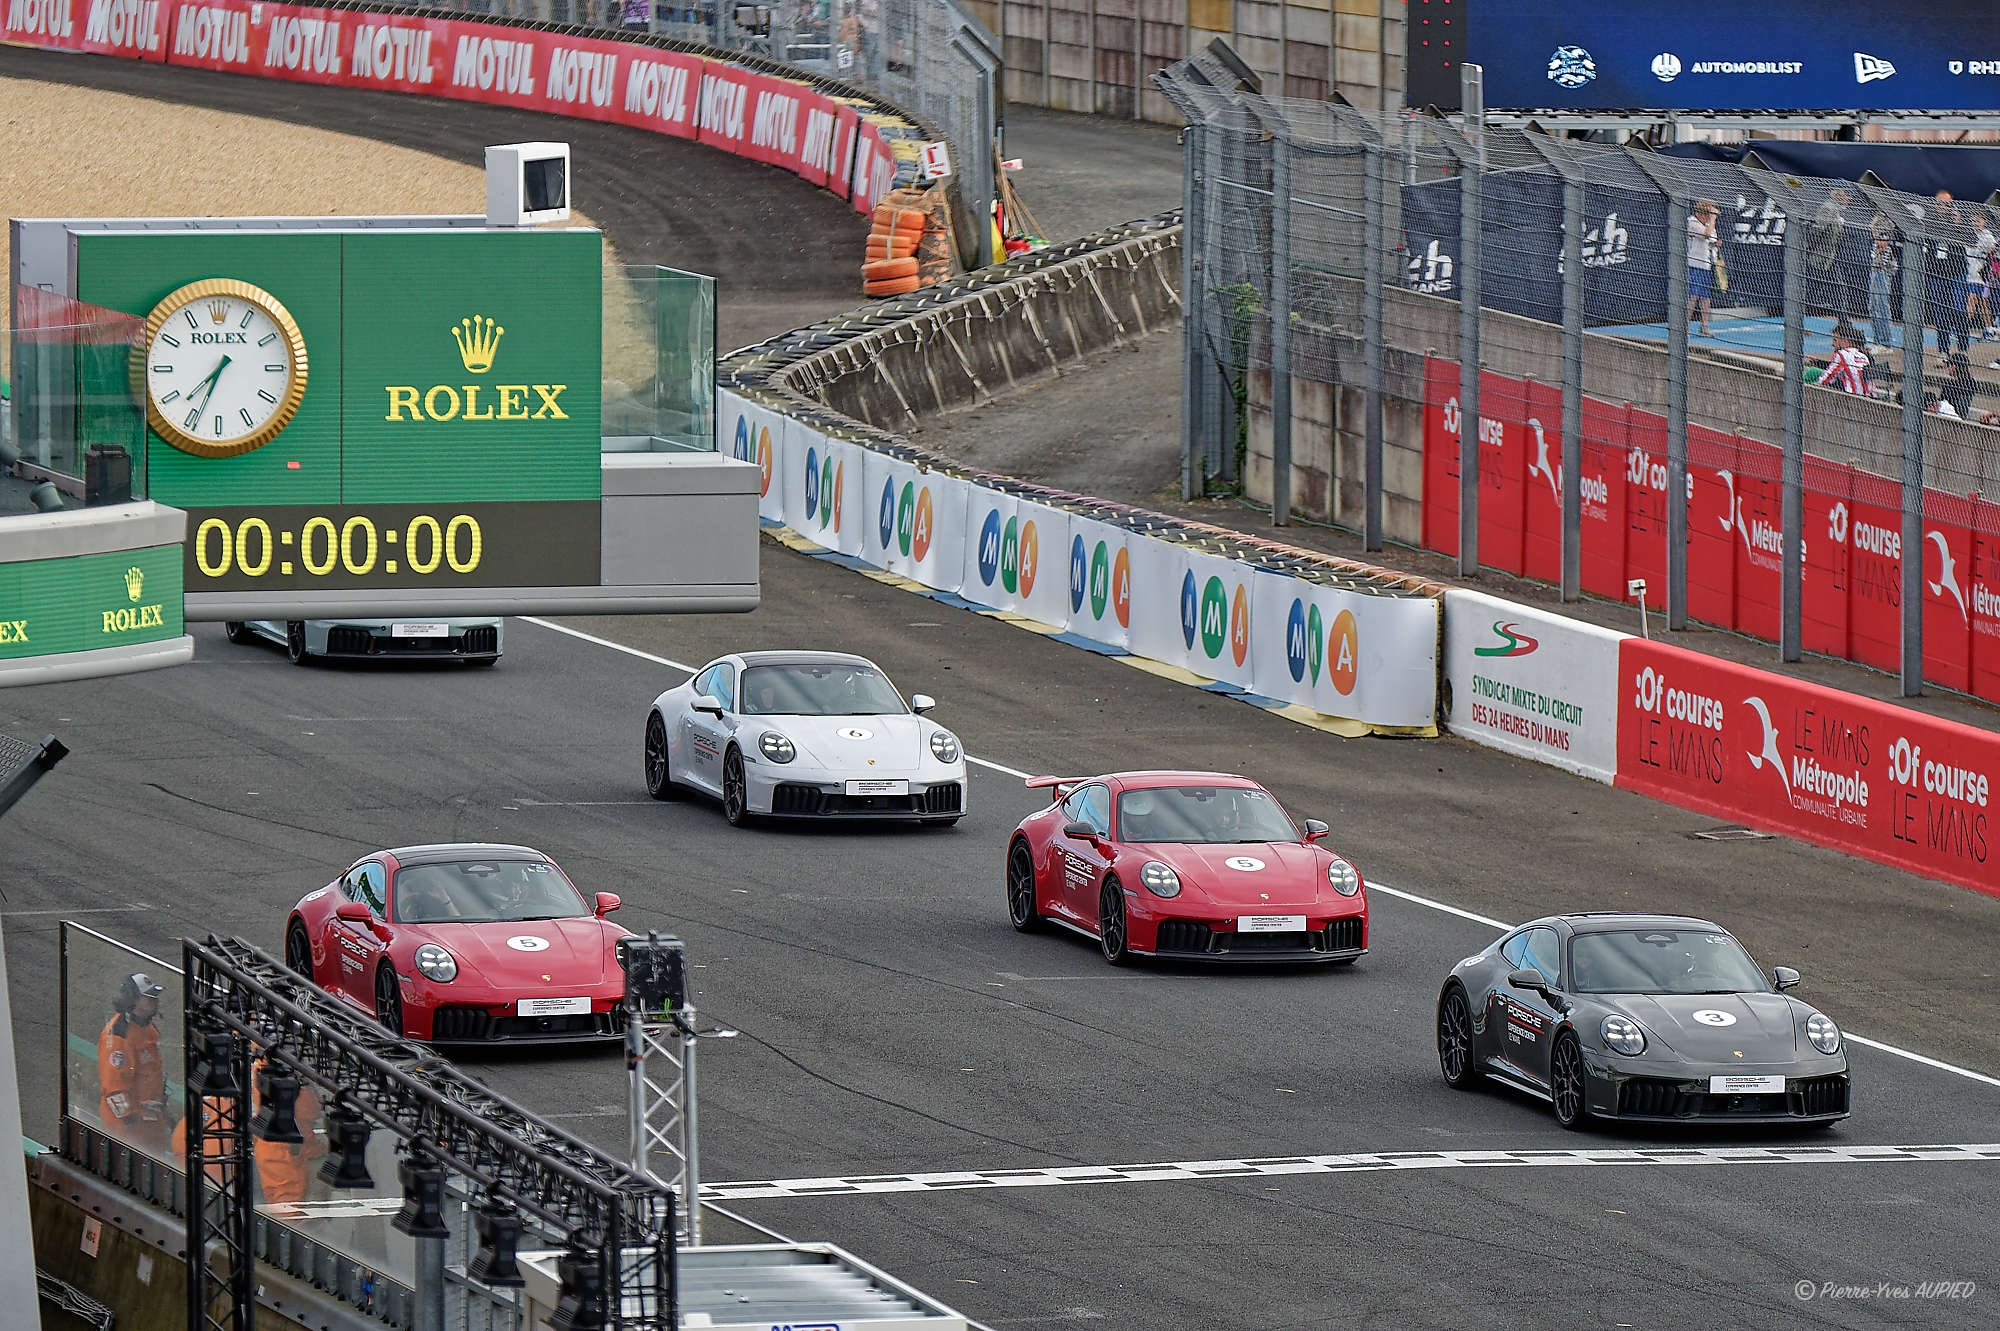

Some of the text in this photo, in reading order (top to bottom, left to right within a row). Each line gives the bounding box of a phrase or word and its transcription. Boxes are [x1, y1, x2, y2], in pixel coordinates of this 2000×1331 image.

[85, 0, 159, 50] MOTUL
[174, 4, 250, 64] MOTUL
[264, 15, 342, 74] MOTUL
[351, 24, 434, 83] MOTUL
[453, 35, 535, 96] MOTUL
[1691, 61, 1803, 74] AUTOMOBILIST
[624, 59, 688, 122] MOTUL
[190, 331, 248, 345] ROLEX
[384, 383, 570, 423] ROLEX
[194, 513, 484, 579] 00:00:00
[1854, 519, 1902, 561] course
[101, 603, 165, 634] ROLEX
[1472, 674, 1583, 727] SYNDICAT MIXTE DU CIRCUIT
[1666, 687, 1724, 731] course
[849, 730, 863, 738] 6
[1472, 703, 1570, 752] DES 24 HEURES DU MANS
[1640, 716, 1723, 785] LE MANS
[1794, 706, 1870, 767] LE MANS
[1793, 754, 1869, 808] Métropole
[1923, 759, 1989, 808] course
[1839, 806, 1868, 830] URBAINE
[1893, 788, 1988, 864] LE MANS
[1065, 854, 1093, 873] PORSCHE
[1237, 859, 1254, 868] 5
[519, 938, 538, 948] 5
[1507, 1004, 1542, 1028] PORSCHE
[1704, 1013, 1725, 1023] 3
